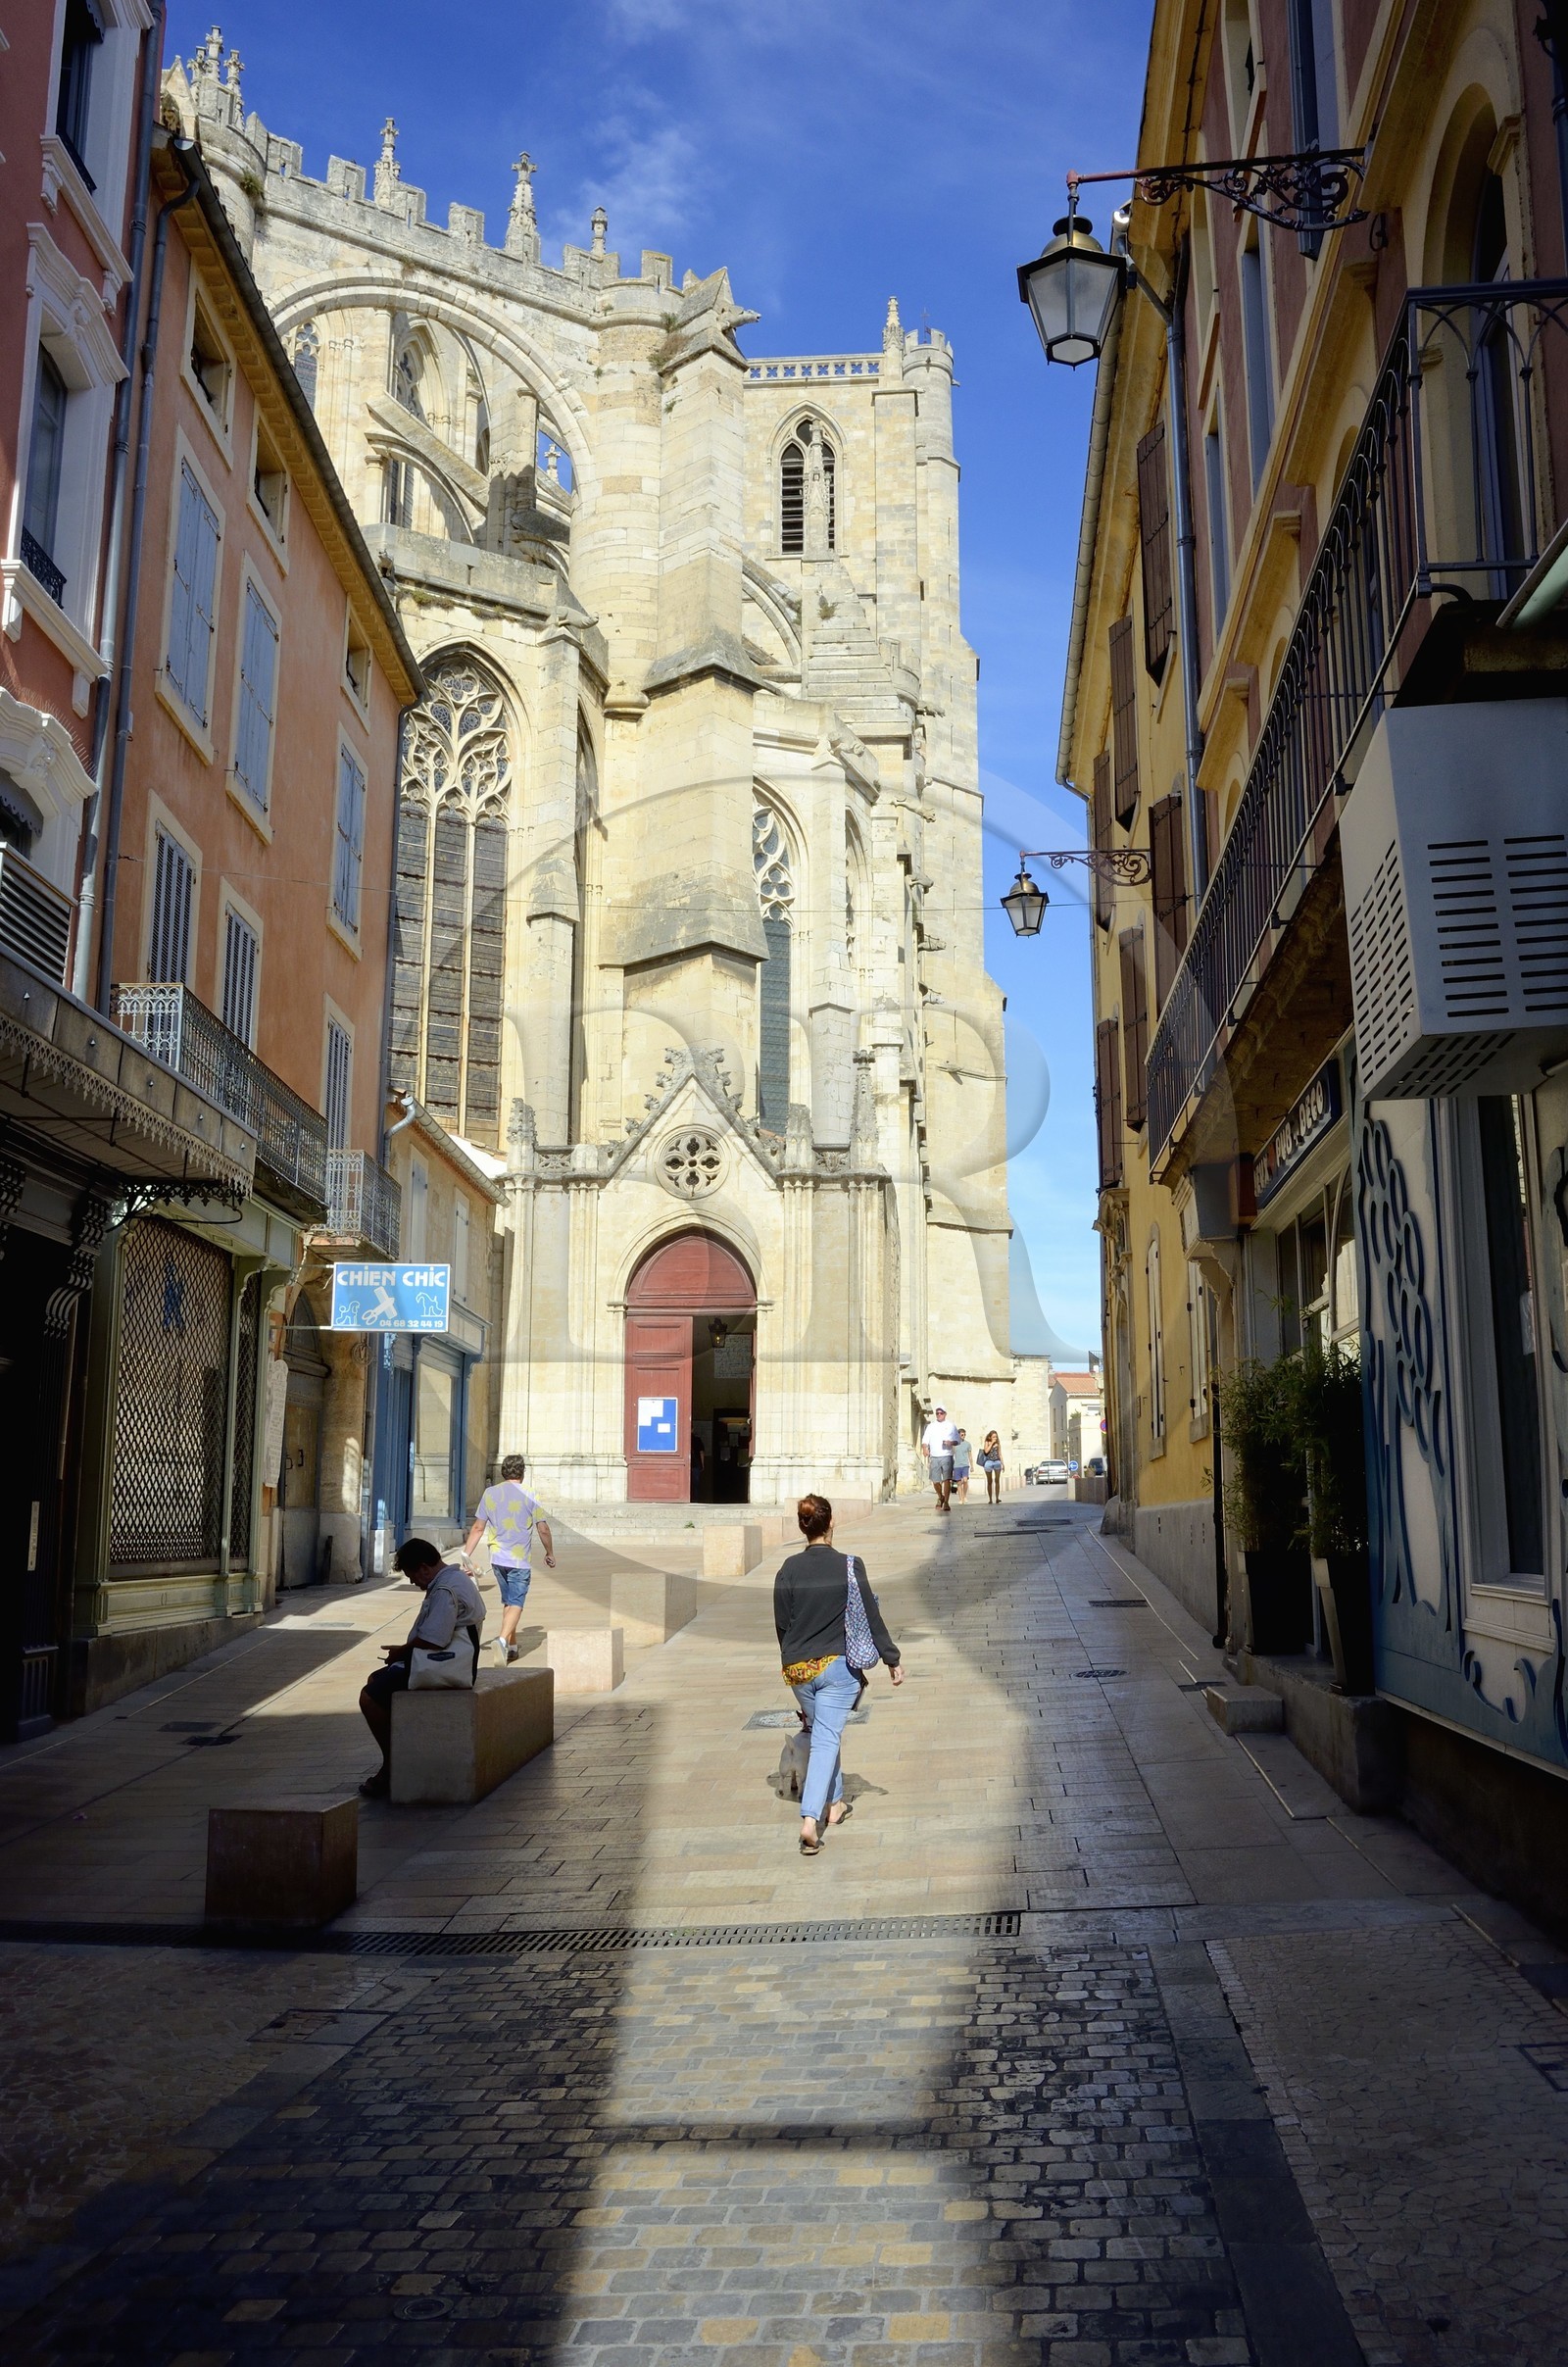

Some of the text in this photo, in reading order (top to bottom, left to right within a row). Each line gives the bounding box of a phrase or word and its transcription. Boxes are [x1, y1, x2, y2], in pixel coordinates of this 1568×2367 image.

[1276, 1122, 1293, 1167] PUB
[393, 1319, 406, 1328] 68
[407, 1319, 419, 1328] 32
[420, 1319, 432, 1328] 44
